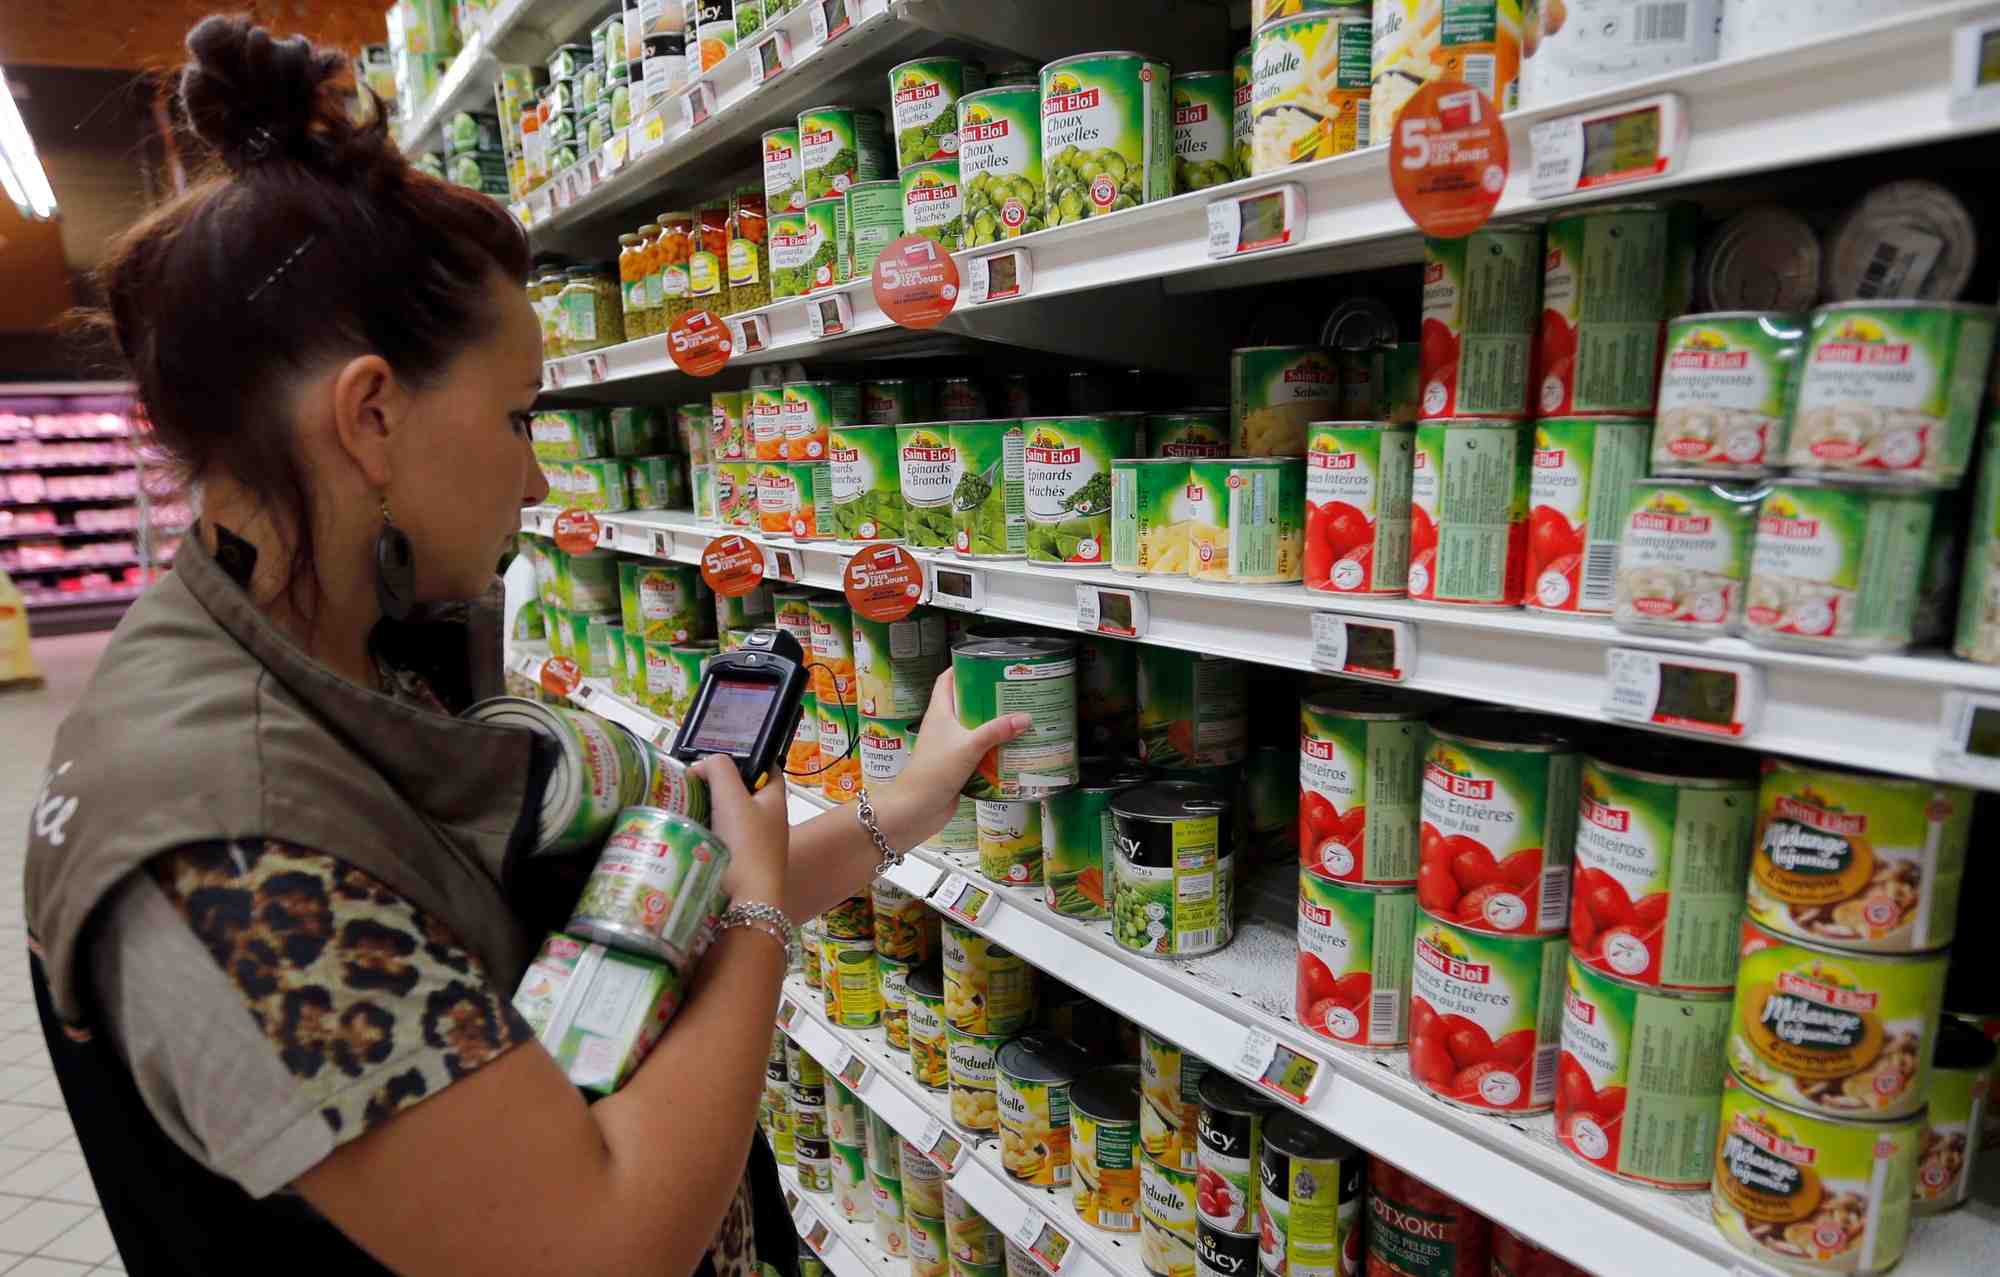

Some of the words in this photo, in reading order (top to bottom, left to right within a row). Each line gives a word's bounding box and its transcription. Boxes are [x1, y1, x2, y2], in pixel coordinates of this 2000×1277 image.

[916, 86, 936, 98] Eloi
[1044, 98, 1064, 113] Saint
[1068, 92, 1093, 109] Eloi
[1176, 107, 1202, 122] Eloi
[981, 123, 1003, 138] Eloi
[1402, 118, 1427, 170] 5
[909, 190, 929, 201] Saint
[933, 187, 954, 198] Eloi
[880, 260, 900, 289] 5
[672, 330, 688, 352] 5
[904, 449, 927, 460] Saint
[1026, 450, 1047, 463] Saint
[1051, 450, 1075, 464] Eloi
[1327, 455, 1351, 468] Eloi
[907, 462, 951, 476] Epinards
[1028, 468, 1073, 483] Epinards
[705, 553, 721, 574] 5
[852, 564, 870, 589] 5
[1308, 741, 1329, 759] Eloi
[1452, 782, 1486, 798] Eloi
[1449, 799, 1514, 823] Entières
[1592, 807, 1624, 830] Eloi
[1451, 963, 1483, 983] Eloi
[1443, 979, 1511, 1007] Entières
